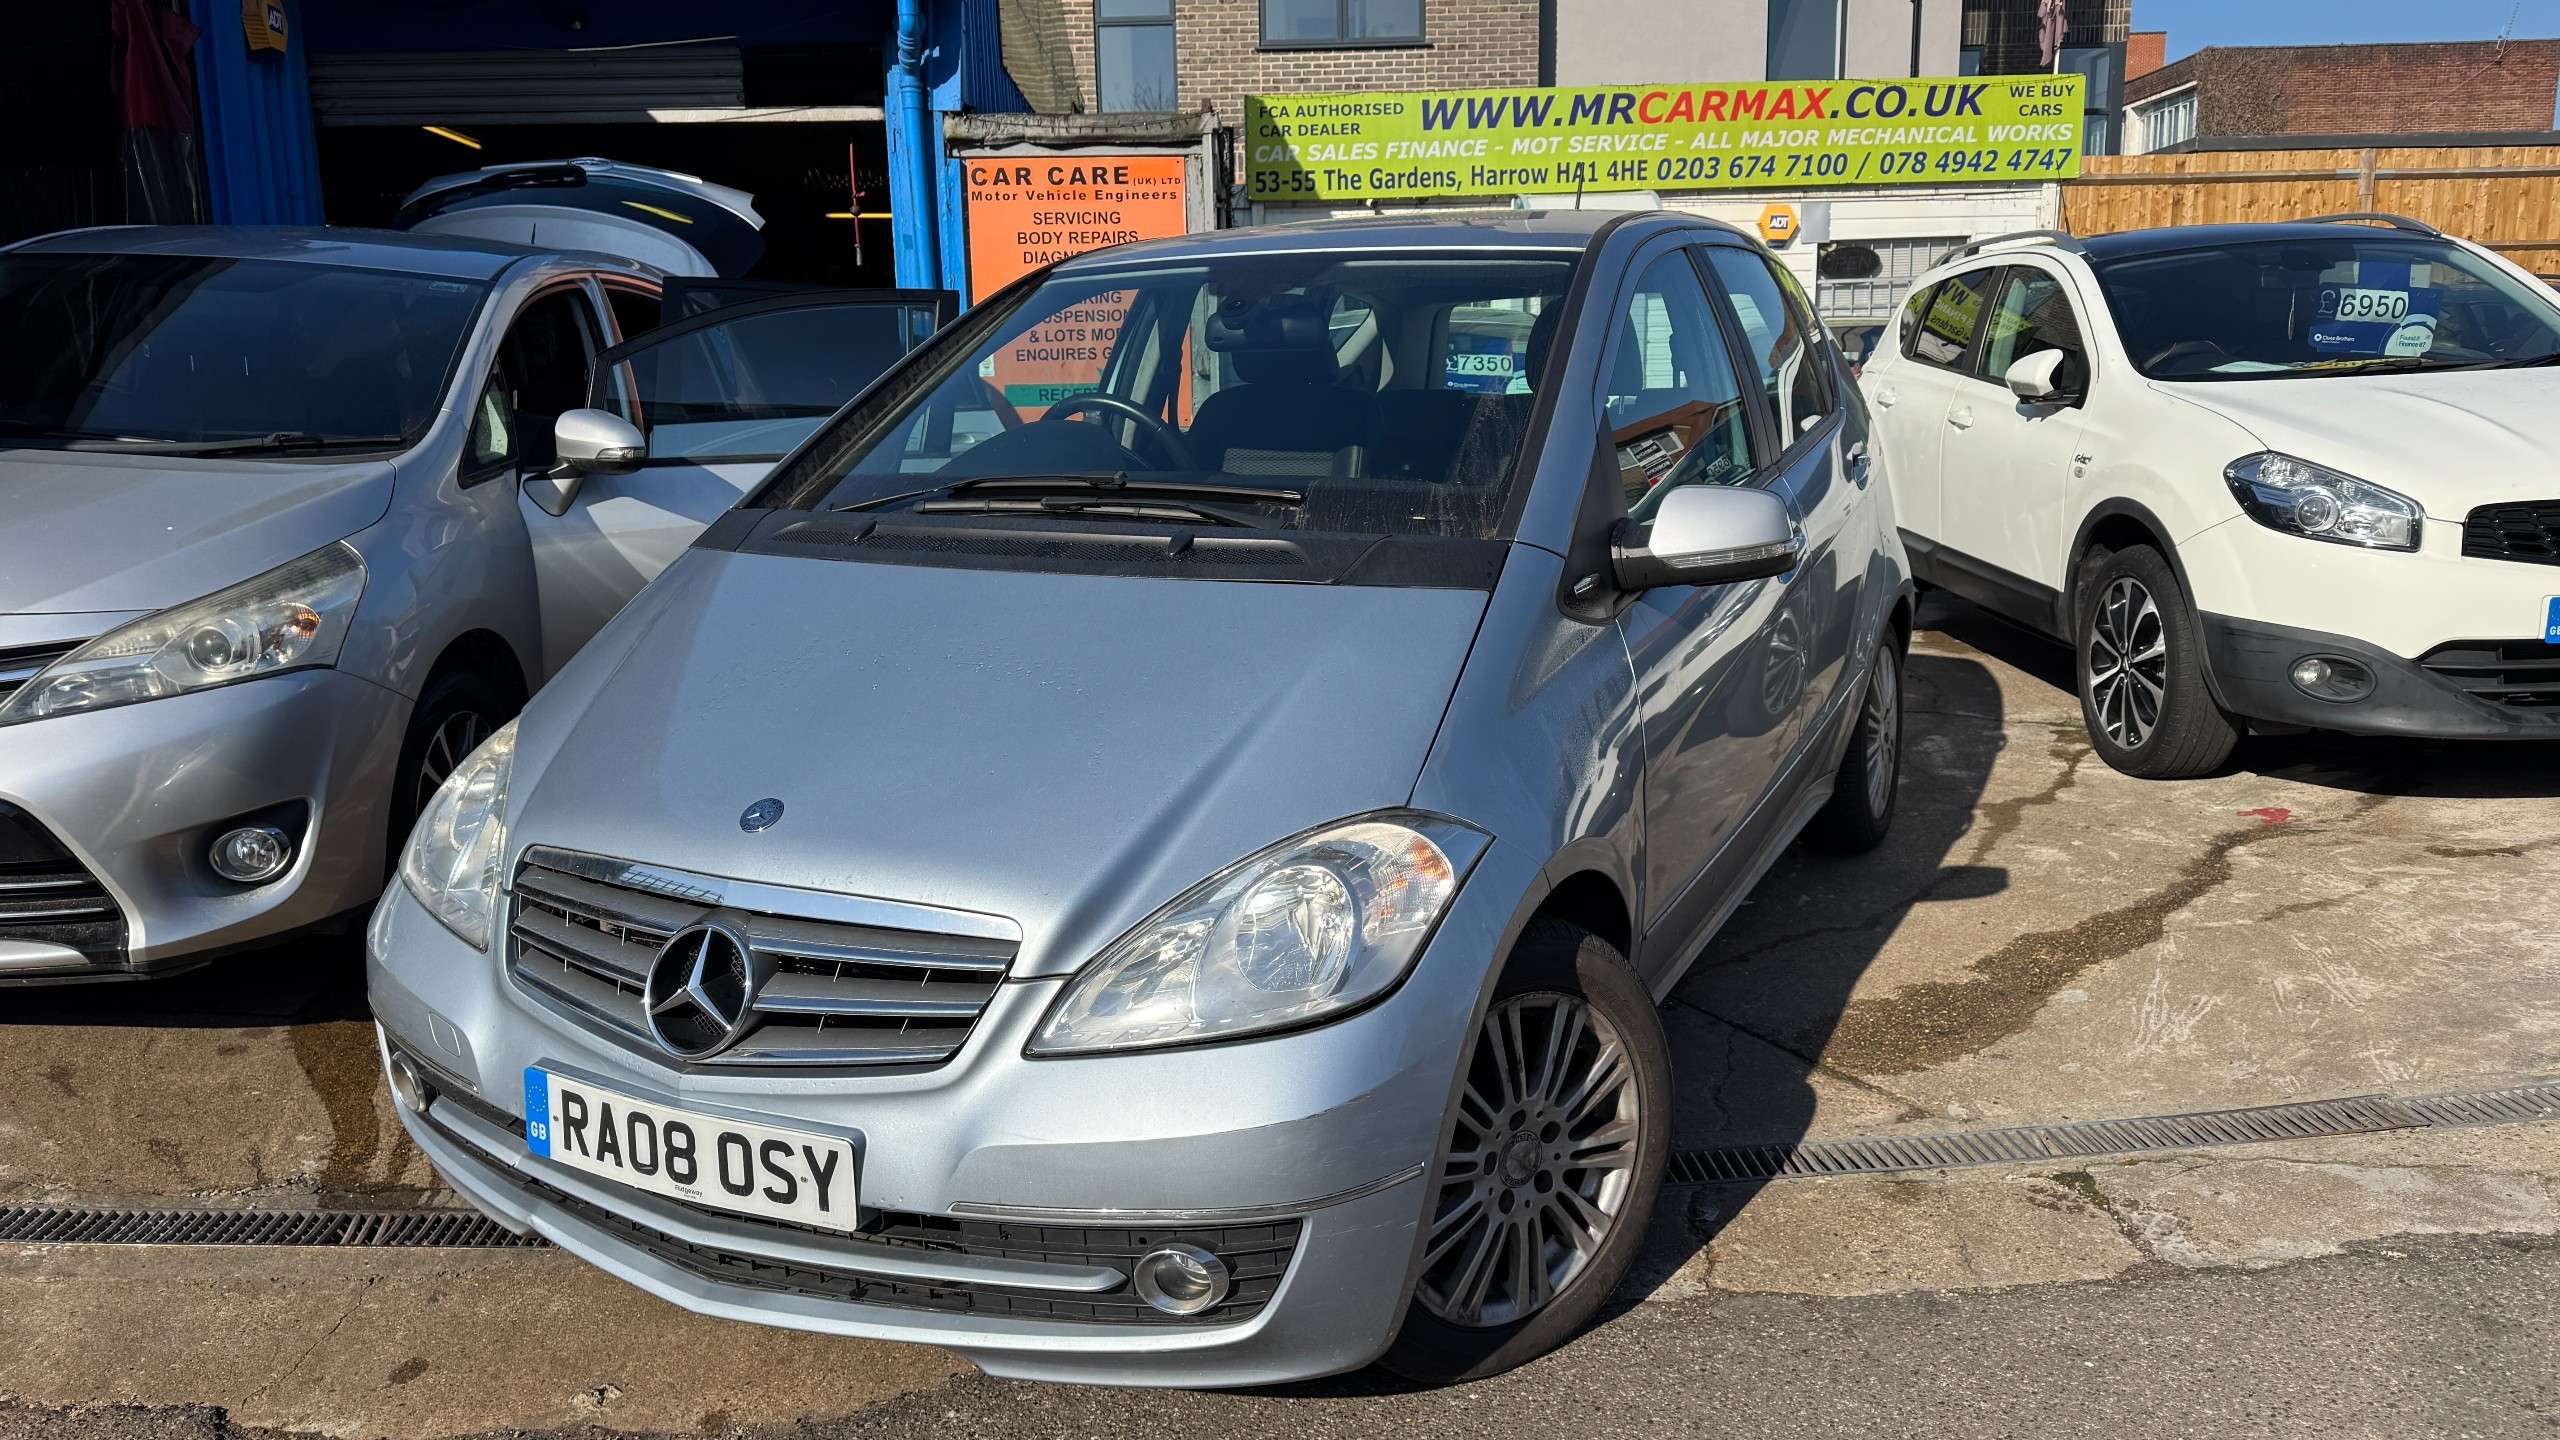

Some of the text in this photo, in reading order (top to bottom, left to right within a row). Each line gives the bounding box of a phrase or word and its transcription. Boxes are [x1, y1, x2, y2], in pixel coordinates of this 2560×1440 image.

[2009, 84, 2076, 98] WE BUY
[1259, 102, 1404, 119] FCA AUTHORISED
[1421, 84, 1987, 131] WWW.MRCARMAX.CO.UK
[2018, 103, 2064, 117] CARS
[1259, 122, 1361, 138] CAR DEALER
[1255, 144, 1298, 164] CAR
[1306, 142, 1379, 162] SALES
[1385, 138, 1489, 161] FINANCE
[1511, 135, 1560, 156] MOT
[1567, 133, 1669, 154] SERVICE
[1690, 130, 1732, 150] ALL
[1743, 128, 1819, 149] MAJOR
[1827, 125, 1978, 147] MECHANICAL
[1987, 123, 2074, 144] WORKS
[971, 166, 1181, 187] CAR CARE (UK) LTD
[1255, 169, 1317, 194] 53-55
[1323, 168, 1362, 191] The
[1369, 164, 1463, 192] Gardens,
[1471, 162, 1548, 187] Harrow
[1557, 160, 1598, 184] HA1
[1606, 158, 1648, 182] 4HE
[1657, 155, 1721, 181] 0203
[1729, 154, 1775, 179] 674
[1785, 152, 1849, 178] 7100
[1879, 149, 1929, 175] 078
[1935, 148, 1998, 173] 4942
[2007, 147, 2073, 172] 4747
[971, 189, 1177, 203] Motor Vehicle Engineers
[1033, 211, 1121, 225] SERVICING
[1769, 215, 1788, 229] ADT
[1017, 231, 1138, 245] BODY REPAIRS
[1023, 251, 1084, 264] DIAGN
[1029, 330, 1040, 343] &
[1045, 328, 1086, 342] LOTS
[1016, 347, 1097, 362] ENQUIRES
[530, 1120, 547, 1141] GB
[561, 1088, 839, 1212] RA08 OSY
